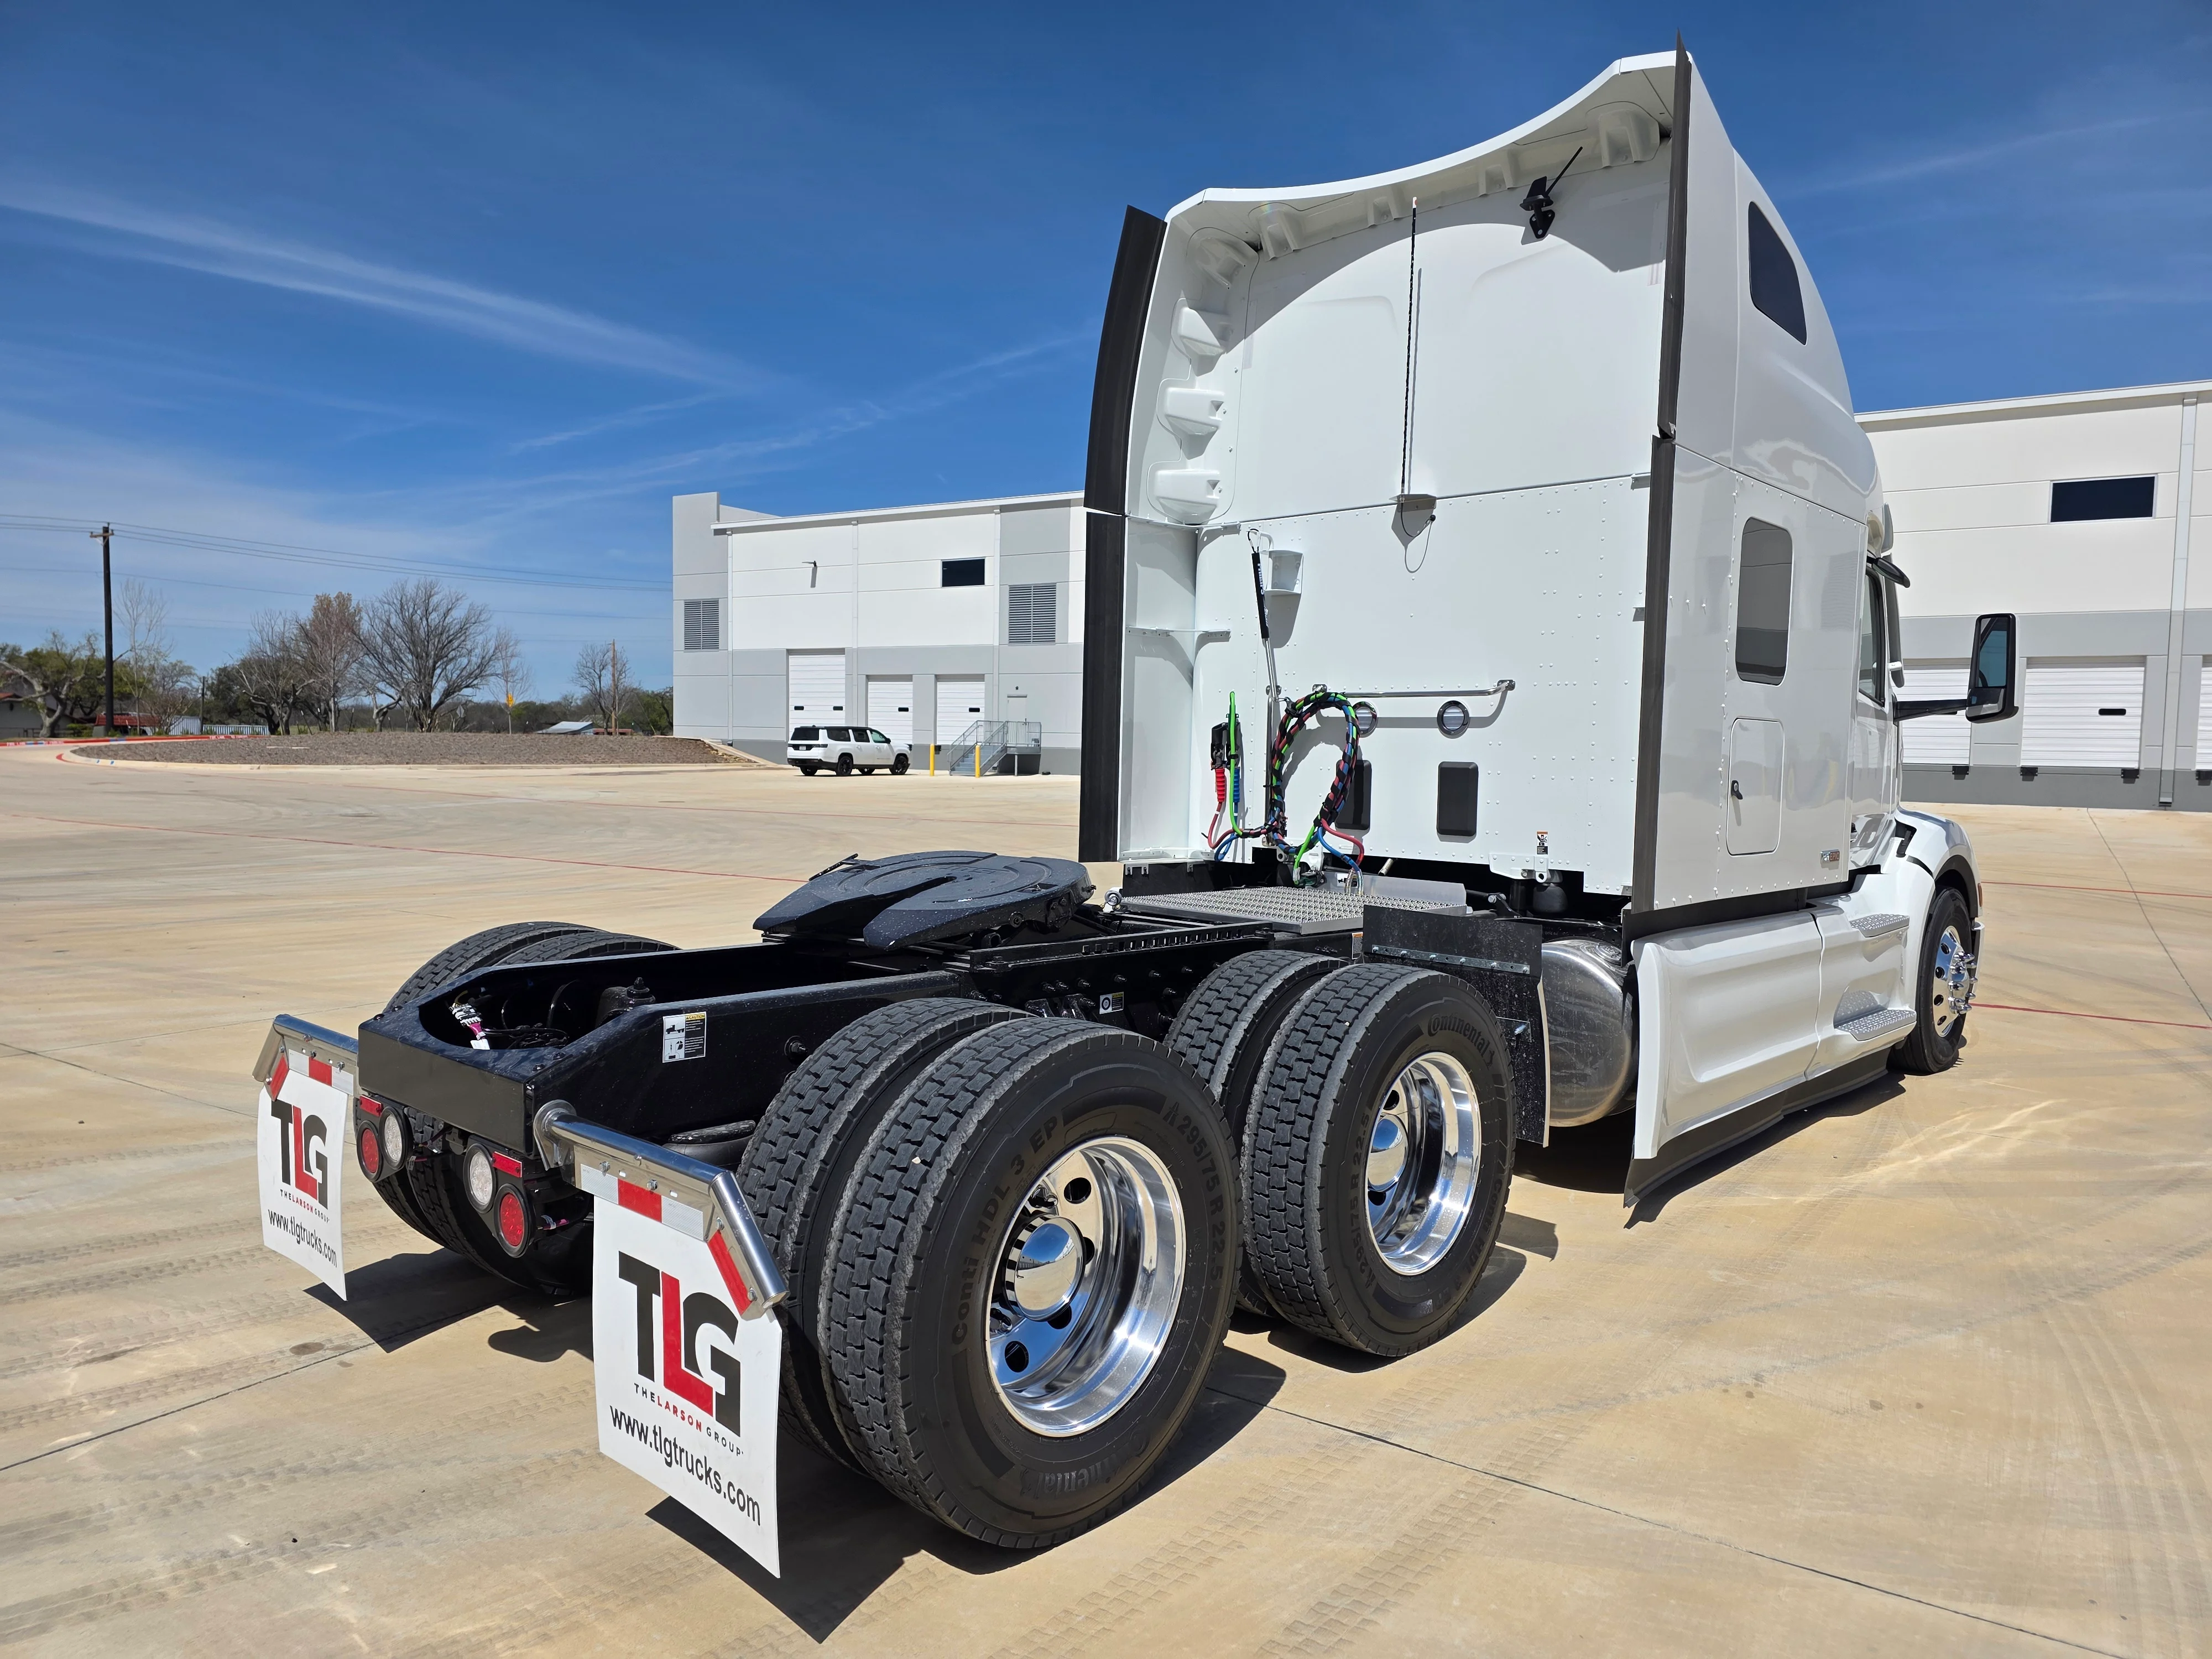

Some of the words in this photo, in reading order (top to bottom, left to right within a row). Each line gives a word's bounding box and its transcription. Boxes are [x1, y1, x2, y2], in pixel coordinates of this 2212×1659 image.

[1428, 1013, 1490, 1058] Continental
[271, 1100, 328, 1210] TLG
[1177, 1115, 1220, 1192] 295/75
[268, 1209, 337, 1268] www.tlgtrucks.com
[314, 1208, 329, 1223] GROUP
[951, 1256, 979, 1345] Conti
[971, 1182, 1011, 1246] HDL
[1010, 1154, 1025, 1175] 3
[1029, 1116, 1057, 1154] EP
[1209, 1195, 1224, 1216] R
[1210, 1221, 1226, 1281] 22.5
[619, 1250, 741, 1437] TLG
[609, 1405, 761, 1526] www.tlgtrucks.com
[706, 1426, 741, 1457] GROUP
[1033, 1425, 1151, 1500] Ctinental
